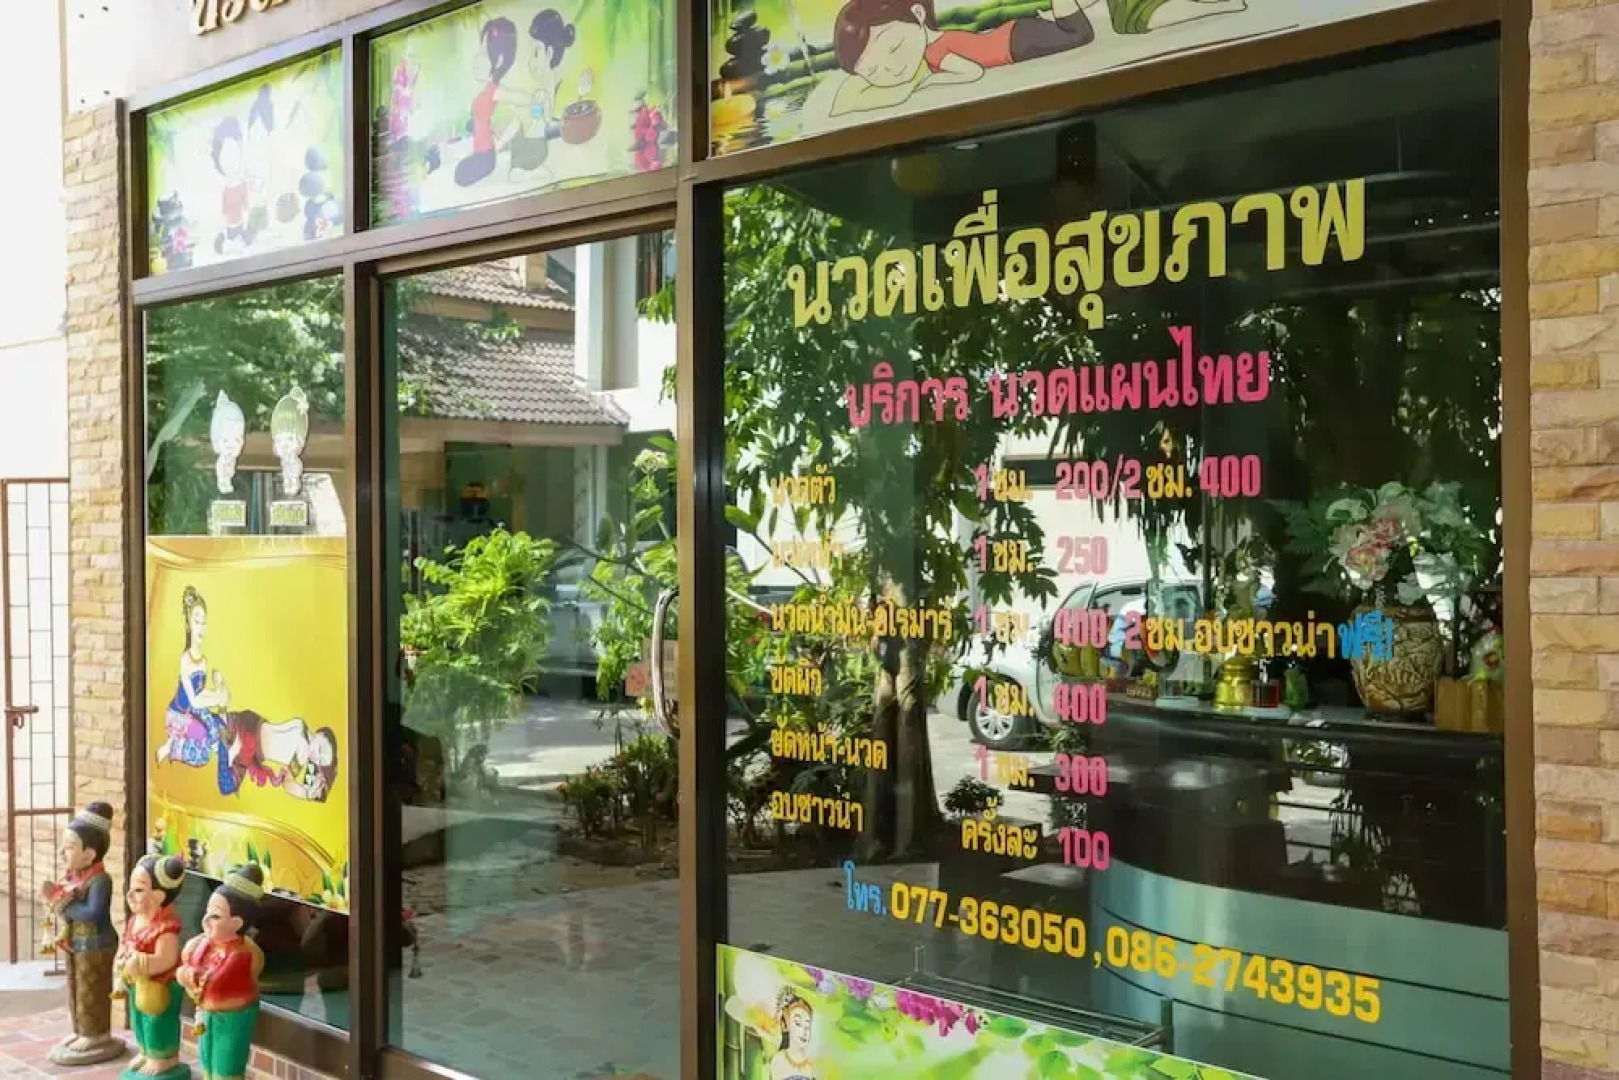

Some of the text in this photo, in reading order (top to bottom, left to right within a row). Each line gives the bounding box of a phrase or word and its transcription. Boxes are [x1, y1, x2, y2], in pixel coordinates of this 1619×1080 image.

[787, 178, 1366, 330] นวดเพื่อสุขภาพ
[846, 326, 1270, 428] บริการ นวดแผนไทย
[974, 463, 988, 501] 1
[1055, 454, 1142, 500] 200/2
[1145, 461, 1193, 498] ชม.
[1199, 454, 1262, 498] 400
[974, 534, 988, 571] 1
[993, 539, 1033, 573] ชม.
[1056, 536, 1109, 575] 250
[1054, 608, 1109, 649] 400
[1125, 613, 1142, 649] 2
[974, 675, 988, 711] 1
[995, 682, 1036, 717] ชม.
[1054, 683, 1107, 724] 400
[974, 746, 989, 780] 1
[1055, 754, 1109, 796] 300
[961, 797, 1039, 860] ครั้งละ
[1056, 827, 1111, 871] 100
[843, 860, 887, 915] โทร.
[891, 882, 1087, 958] 077-363050
